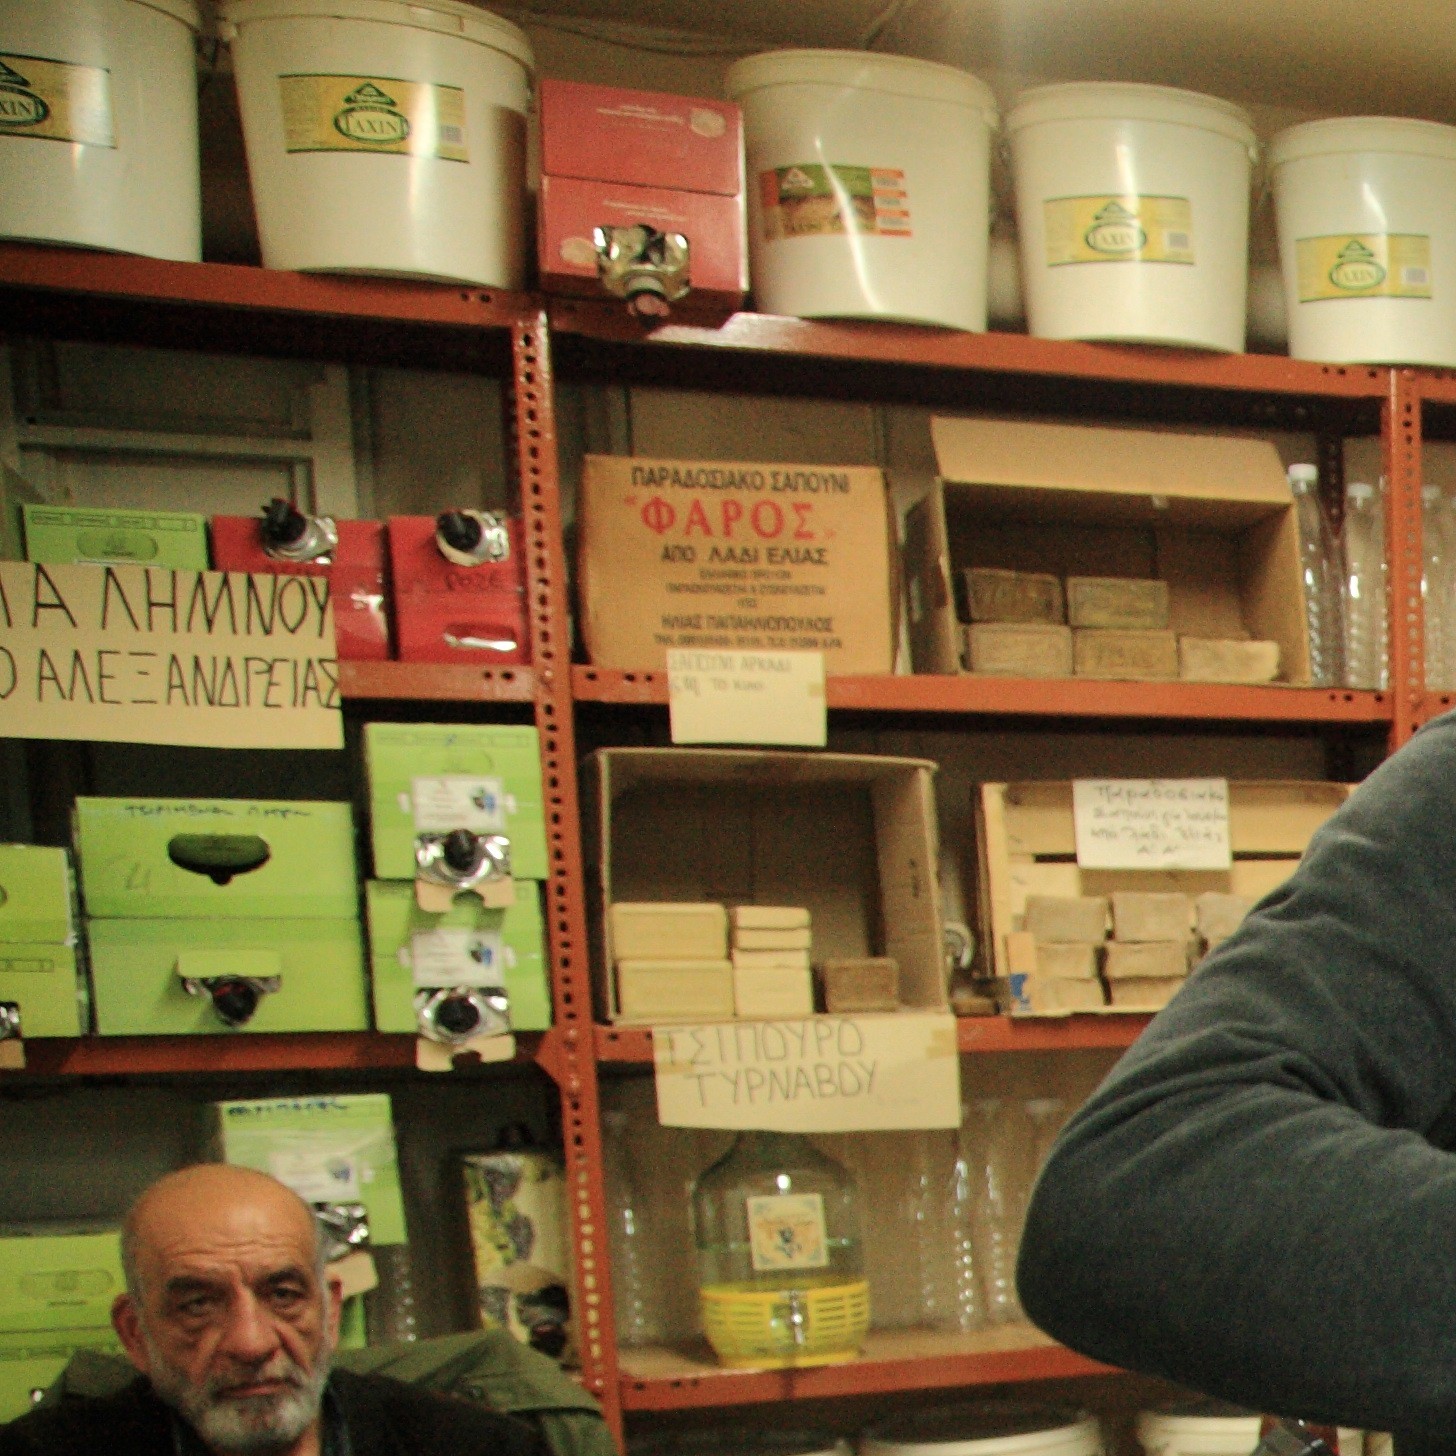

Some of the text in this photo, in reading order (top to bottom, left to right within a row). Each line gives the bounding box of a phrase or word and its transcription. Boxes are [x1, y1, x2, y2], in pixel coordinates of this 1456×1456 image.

[631, 466, 849, 493] ΠΑΡΑΔΟΣΙΑΚΟ ΣΑΠΟΥΝΙ
[709, 547, 758, 564] ΛΑΔΙ
[767, 548, 828, 565] ΕΛΙΑΣ
[101, 566, 329, 638] ΛΗΜΝΟΥ
[37, 650, 342, 709] ΑΛΕΞΑΝΔΡΕΙΑΣ
[653, 1019, 863, 1066] ΤΣΙΠΟΥΡΟ
[683, 1059, 878, 1107] ΤΥΡΝΑΒΟΥ
